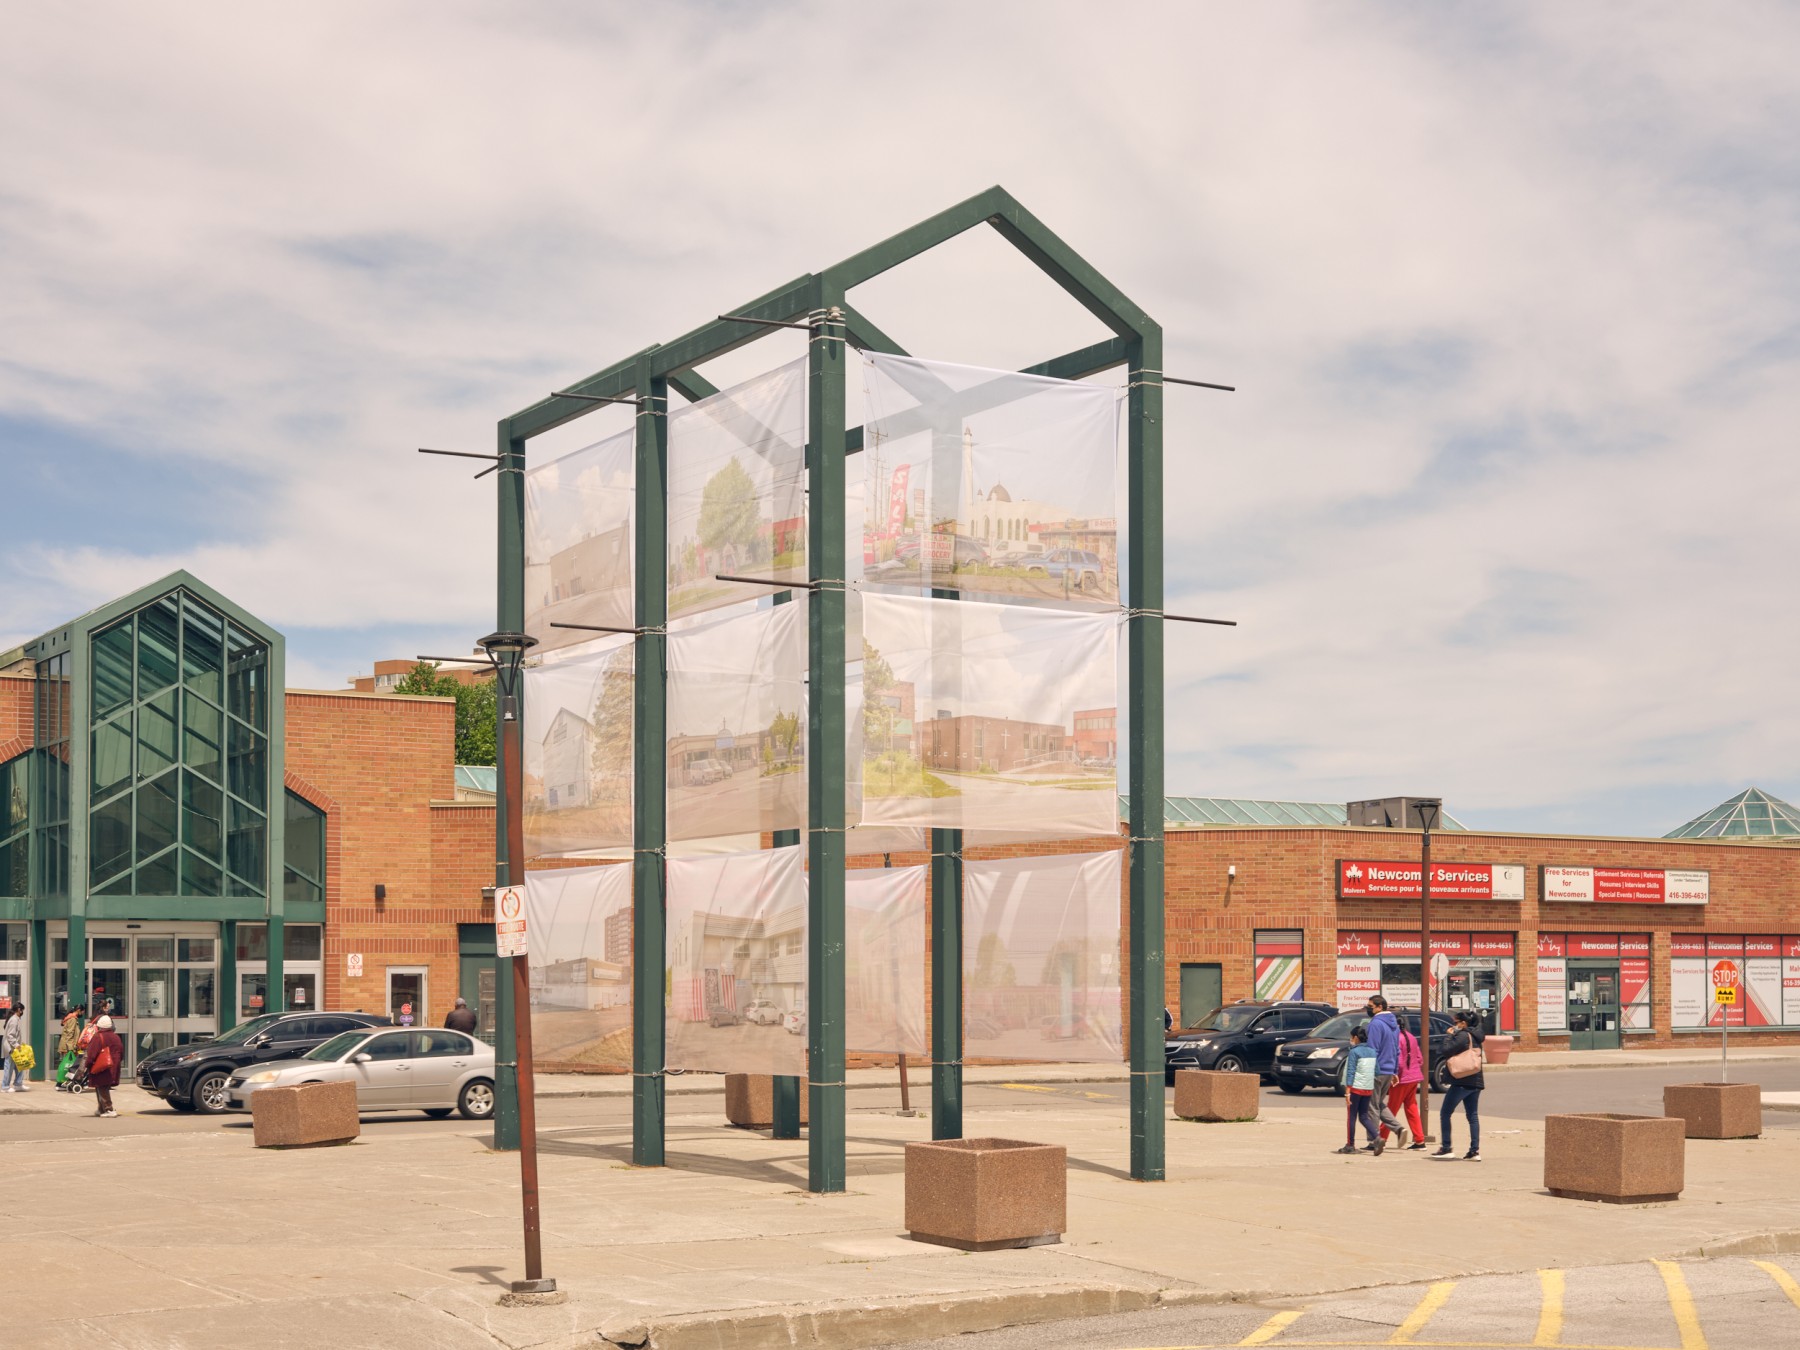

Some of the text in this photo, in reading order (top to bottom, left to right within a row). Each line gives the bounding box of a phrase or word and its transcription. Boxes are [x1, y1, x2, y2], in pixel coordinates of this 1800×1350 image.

[1368, 867, 1434, 881] Newcomr
[1437, 868, 1490, 882] Services
[1368, 884, 1398, 892] Services
[1460, 886, 1490, 894] arrivants
[1598, 891, 1615, 899] Special
[1383, 939, 1461, 949] Newcome Services
[1581, 941, 1649, 950] Newcomer Services
[1708, 941, 1742, 950] Newcomer
[1745, 941, 1774, 950] Services
[1344, 965, 1371, 973] Malvern
[1714, 970, 1737, 982] STOP
